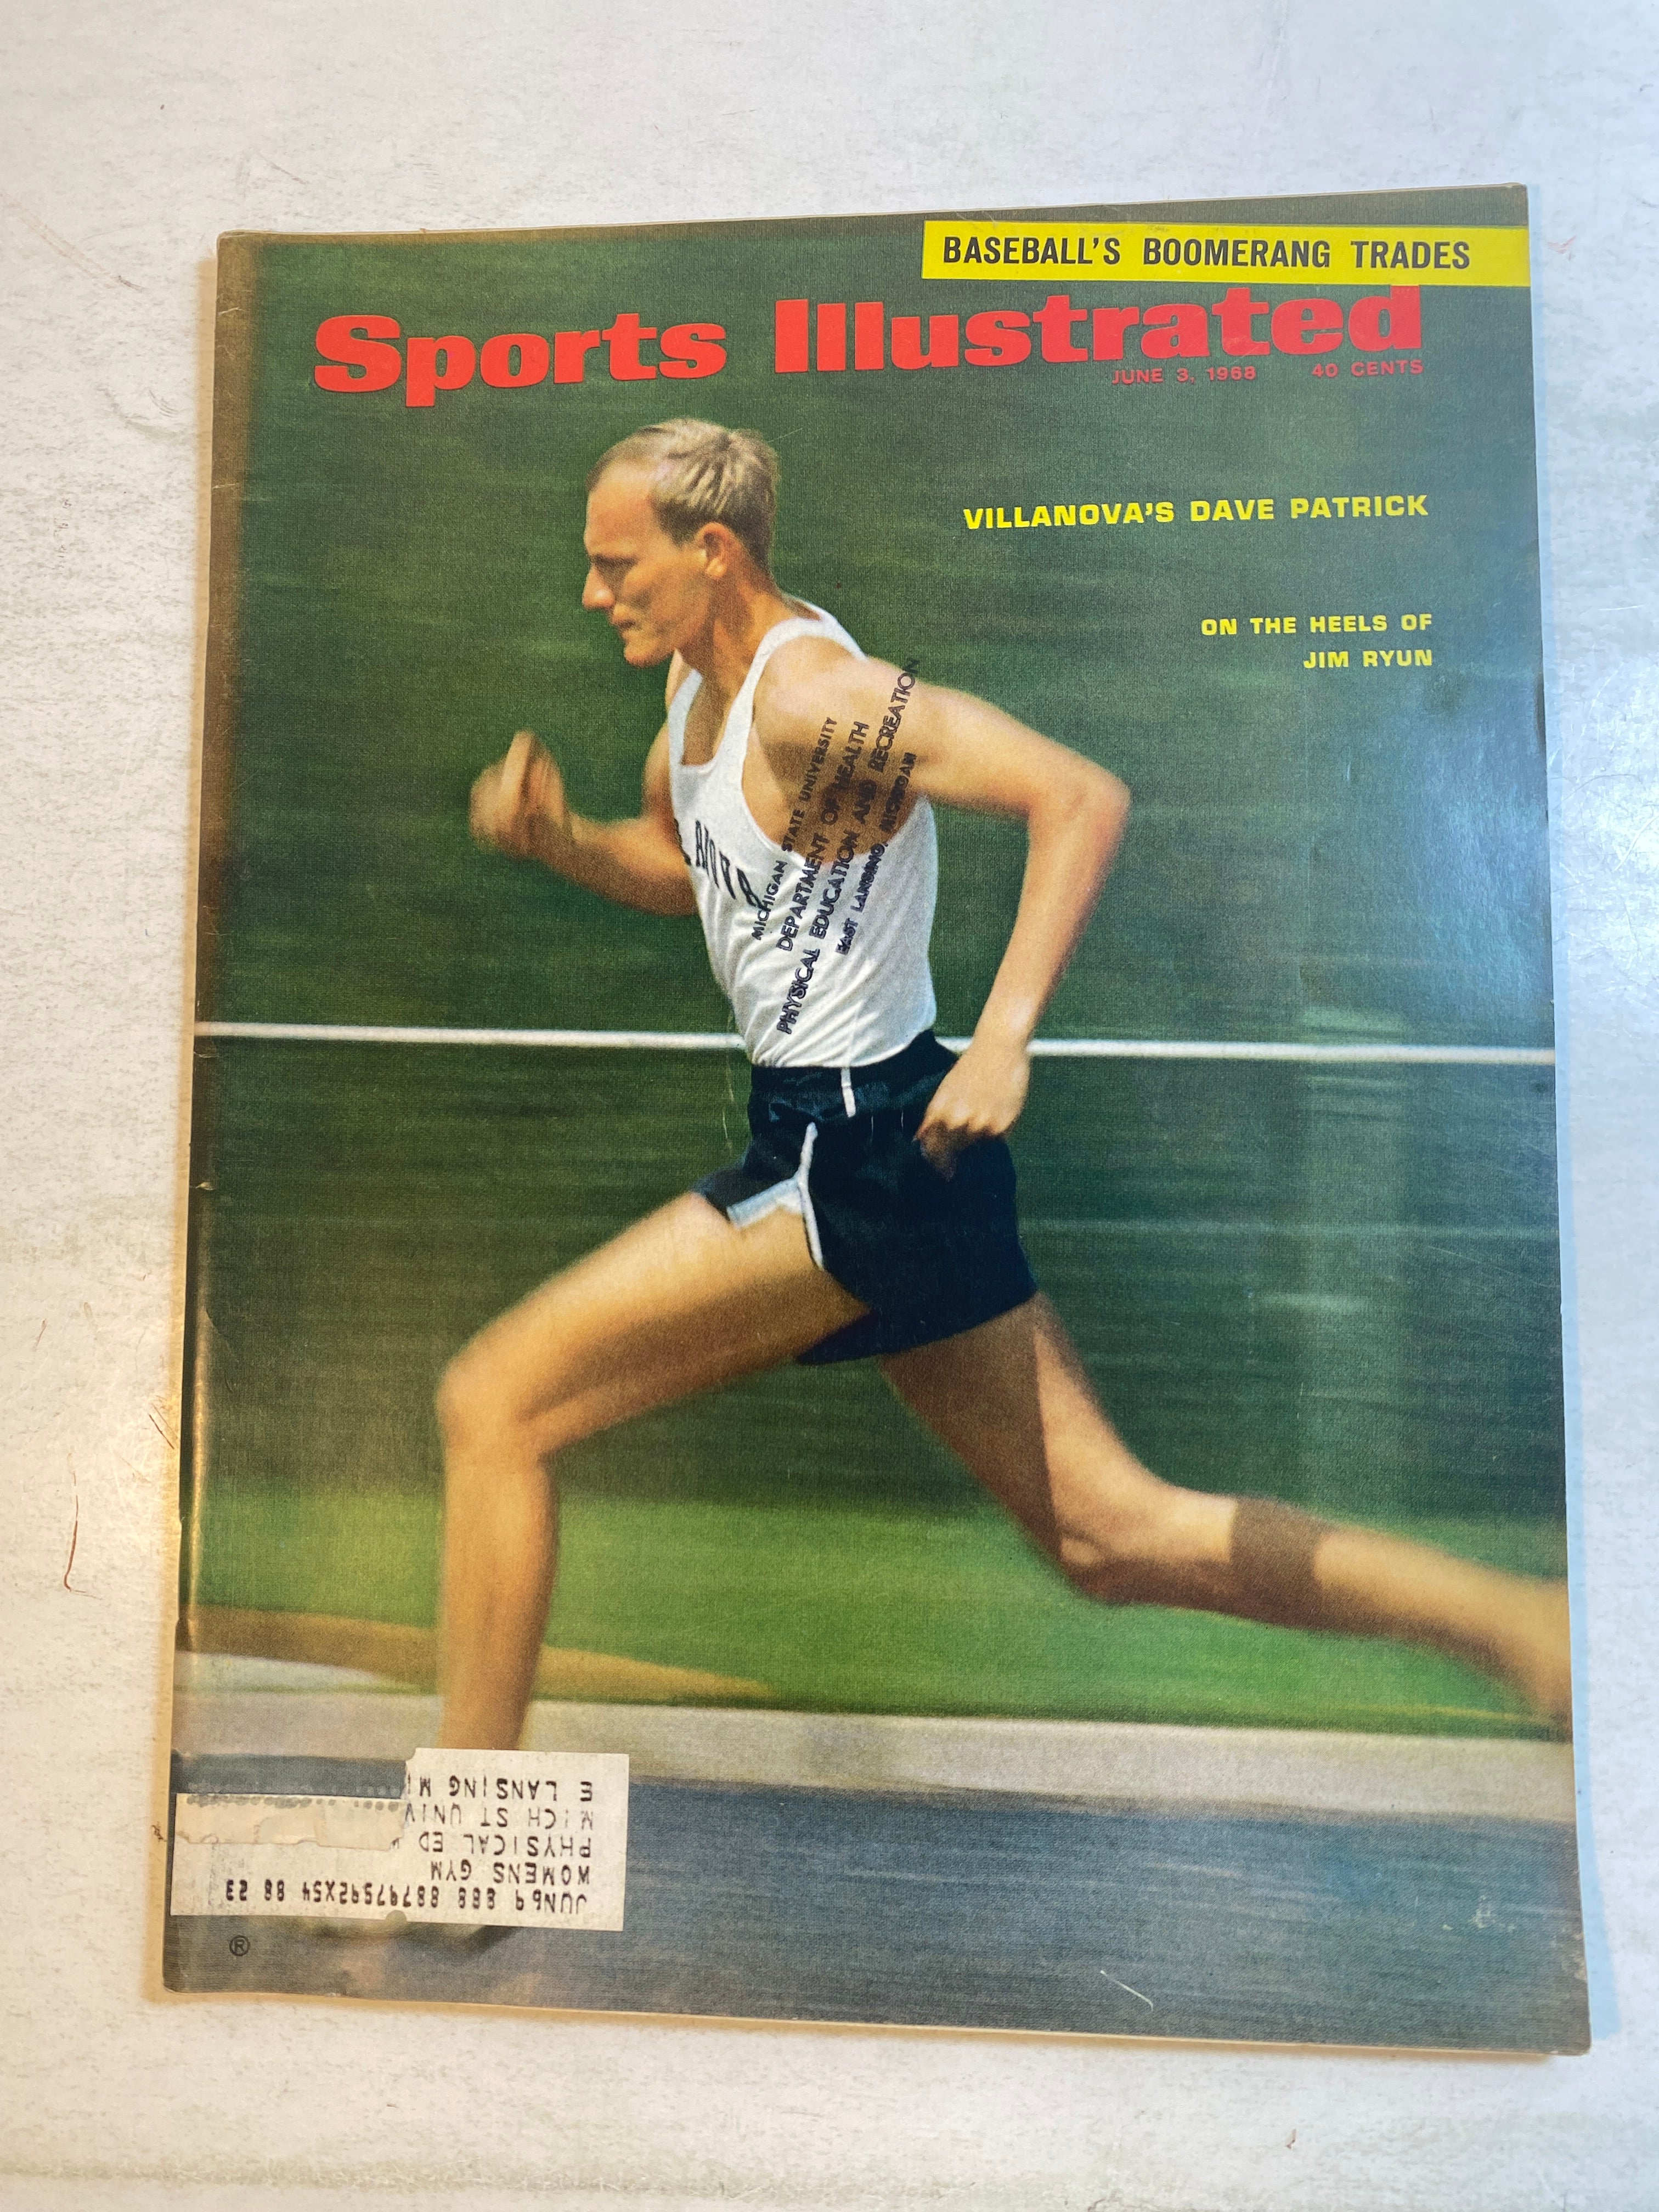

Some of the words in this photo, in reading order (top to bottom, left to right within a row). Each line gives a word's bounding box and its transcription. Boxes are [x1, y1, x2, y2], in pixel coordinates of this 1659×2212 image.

[943, 236, 1120, 265] BASEBALL'S
[1143, 238, 1330, 268] BOOMERANG
[1350, 240, 1470, 269] TRADES
[314, 313, 727, 407] Sports
[775, 284, 1422, 373] Illustrated
[1111, 368, 1164, 385] JUNE
[1177, 368, 1195, 385] 3,
[1207, 365, 1256, 382] 1968
[1312, 362, 1339, 378] 40
[1351, 359, 1424, 377] CENTS
[963, 500, 1175, 529] VILLANOVA'S
[1190, 498, 1274, 522] DAVE
[1290, 494, 1429, 518] PATRICK
[1200, 617, 1237, 635] ON
[1250, 616, 1296, 634] THE
[1310, 614, 1387, 633] HEELS
[1401, 613, 1432, 631] OF
[1303, 650, 1350, 668] JIM
[1363, 649, 1432, 667] RYUN
[752, 860, 788, 941] MICHIGAN
[781, 808, 805, 853] STATE
[799, 716, 838, 802] UNIVERSITY
[775, 832, 830, 952] DEPARTMENT
[822, 795, 841, 825] OF
[835, 721, 870, 792] HEALTH
[775, 947, 820, 1035] PHYSICAL
[809, 829, 860, 940] EDUCATION
[854, 778, 877, 824] AND
[867, 659, 919, 773] RECREATION
[835, 917, 859, 956] EAST
[448, 1774, 557, 1802] LANSING
[580, 1781, 593, 1802] E
[404, 1803, 462, 1825] UNIV
[481, 1807, 508, 1827] ST
[528, 1808, 593, 1830] MICH
[419, 1831, 444, 1852] ED
[463, 1833, 591, 1858] PHYSICAL
[431, 1859, 472, 1881] GYM
[493, 1861, 590, 1886] WOMENS
[225, 1879, 249, 1901] 23
[264, 1878, 285, 1901] 88
